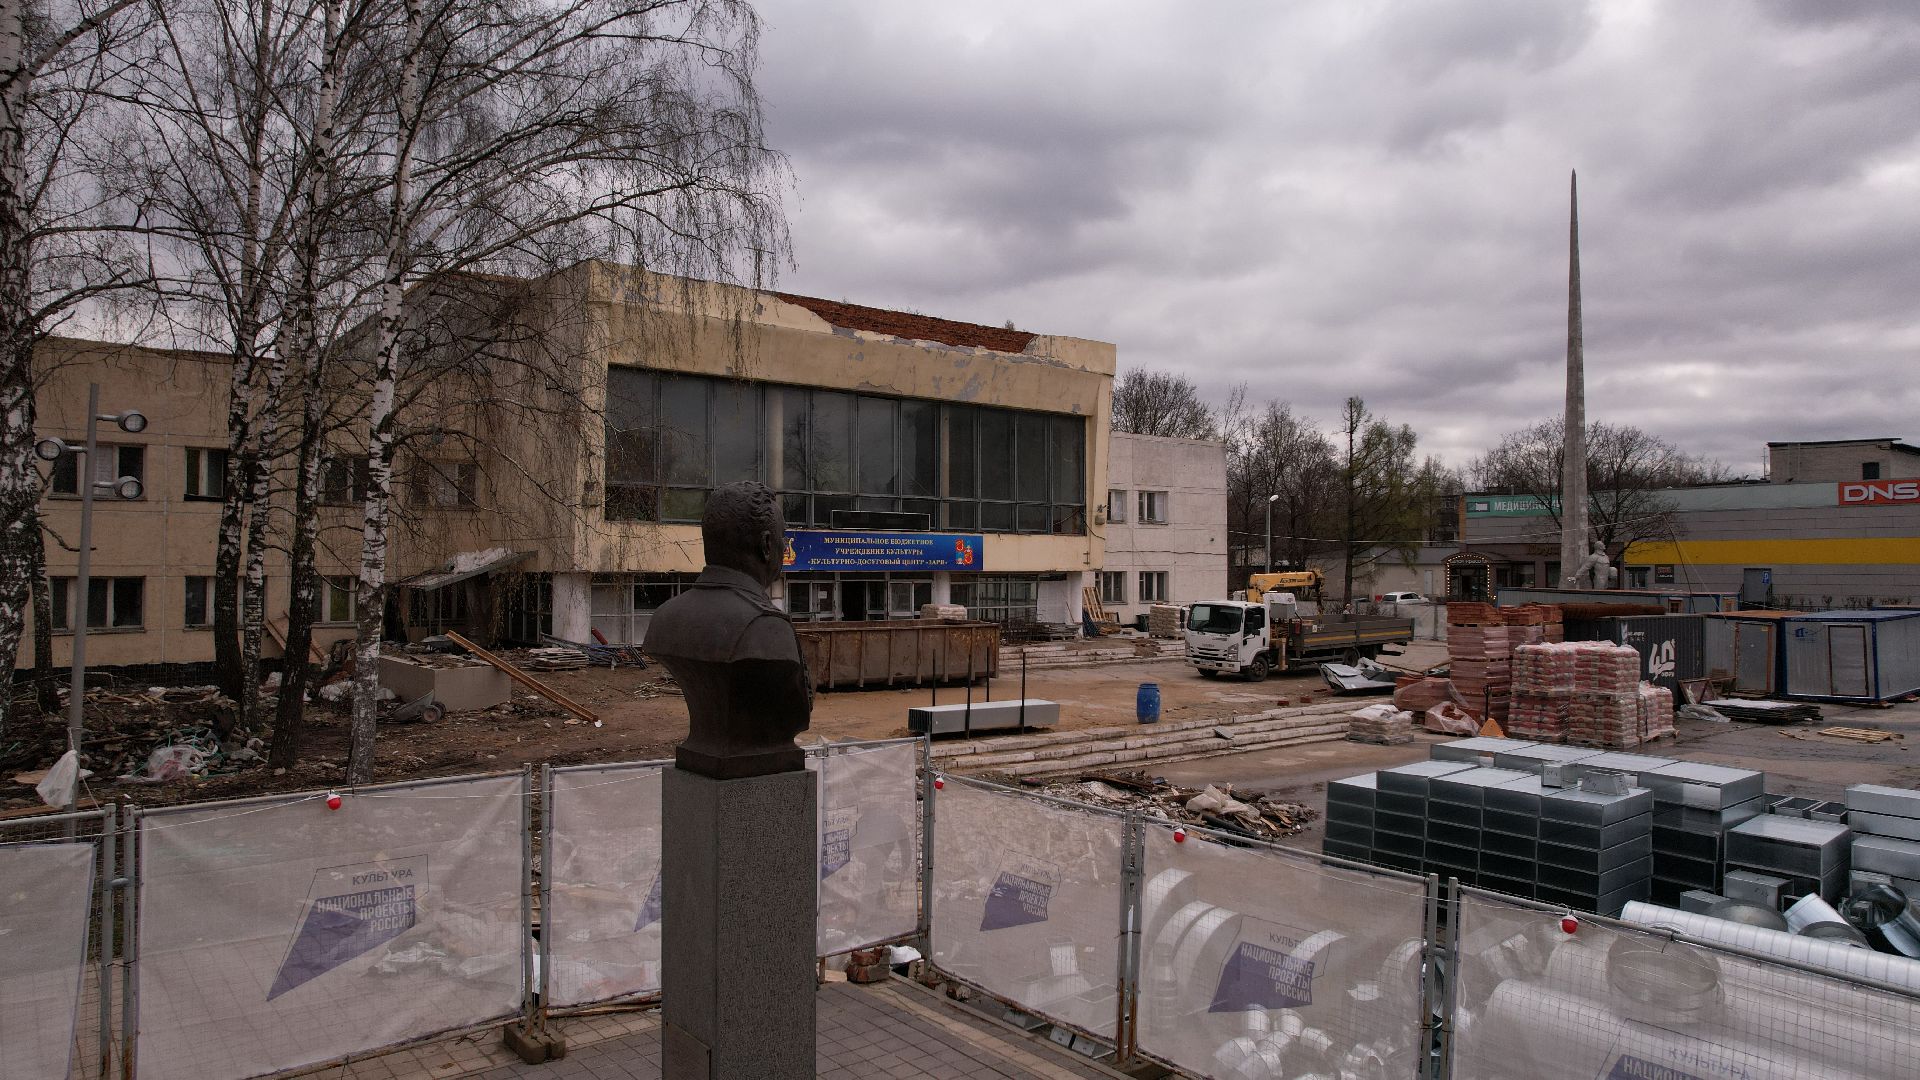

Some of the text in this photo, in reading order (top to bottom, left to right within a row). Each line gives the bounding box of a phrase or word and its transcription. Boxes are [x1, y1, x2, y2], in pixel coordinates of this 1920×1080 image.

[1843, 482, 1919, 502] DNS
[824, 537, 934, 546] МУНИЦИПАЛЬНОЕ БЮДЖЕТНОЕ
[352, 869, 413, 885] КУЛЬТУРА
[1001, 872, 1051, 897] НАЦИОНАЛЬНЫЕ
[316, 886, 414, 913] НАЦИОНАЛЬНЫЕ
[1018, 890, 1048, 908] ПРОЕКТЫ
[360, 900, 415, 921] ПРОЕКТЫ
[1022, 902, 1048, 919] РОССИИ
[370, 913, 414, 933] РОССИИ
[1241, 943, 1313, 977] НАЦИОНАЛЬНЫЕ
[1268, 965, 1311, 991] ПРОЕКТЫ
[1275, 982, 1311, 1003] РОССИИ
